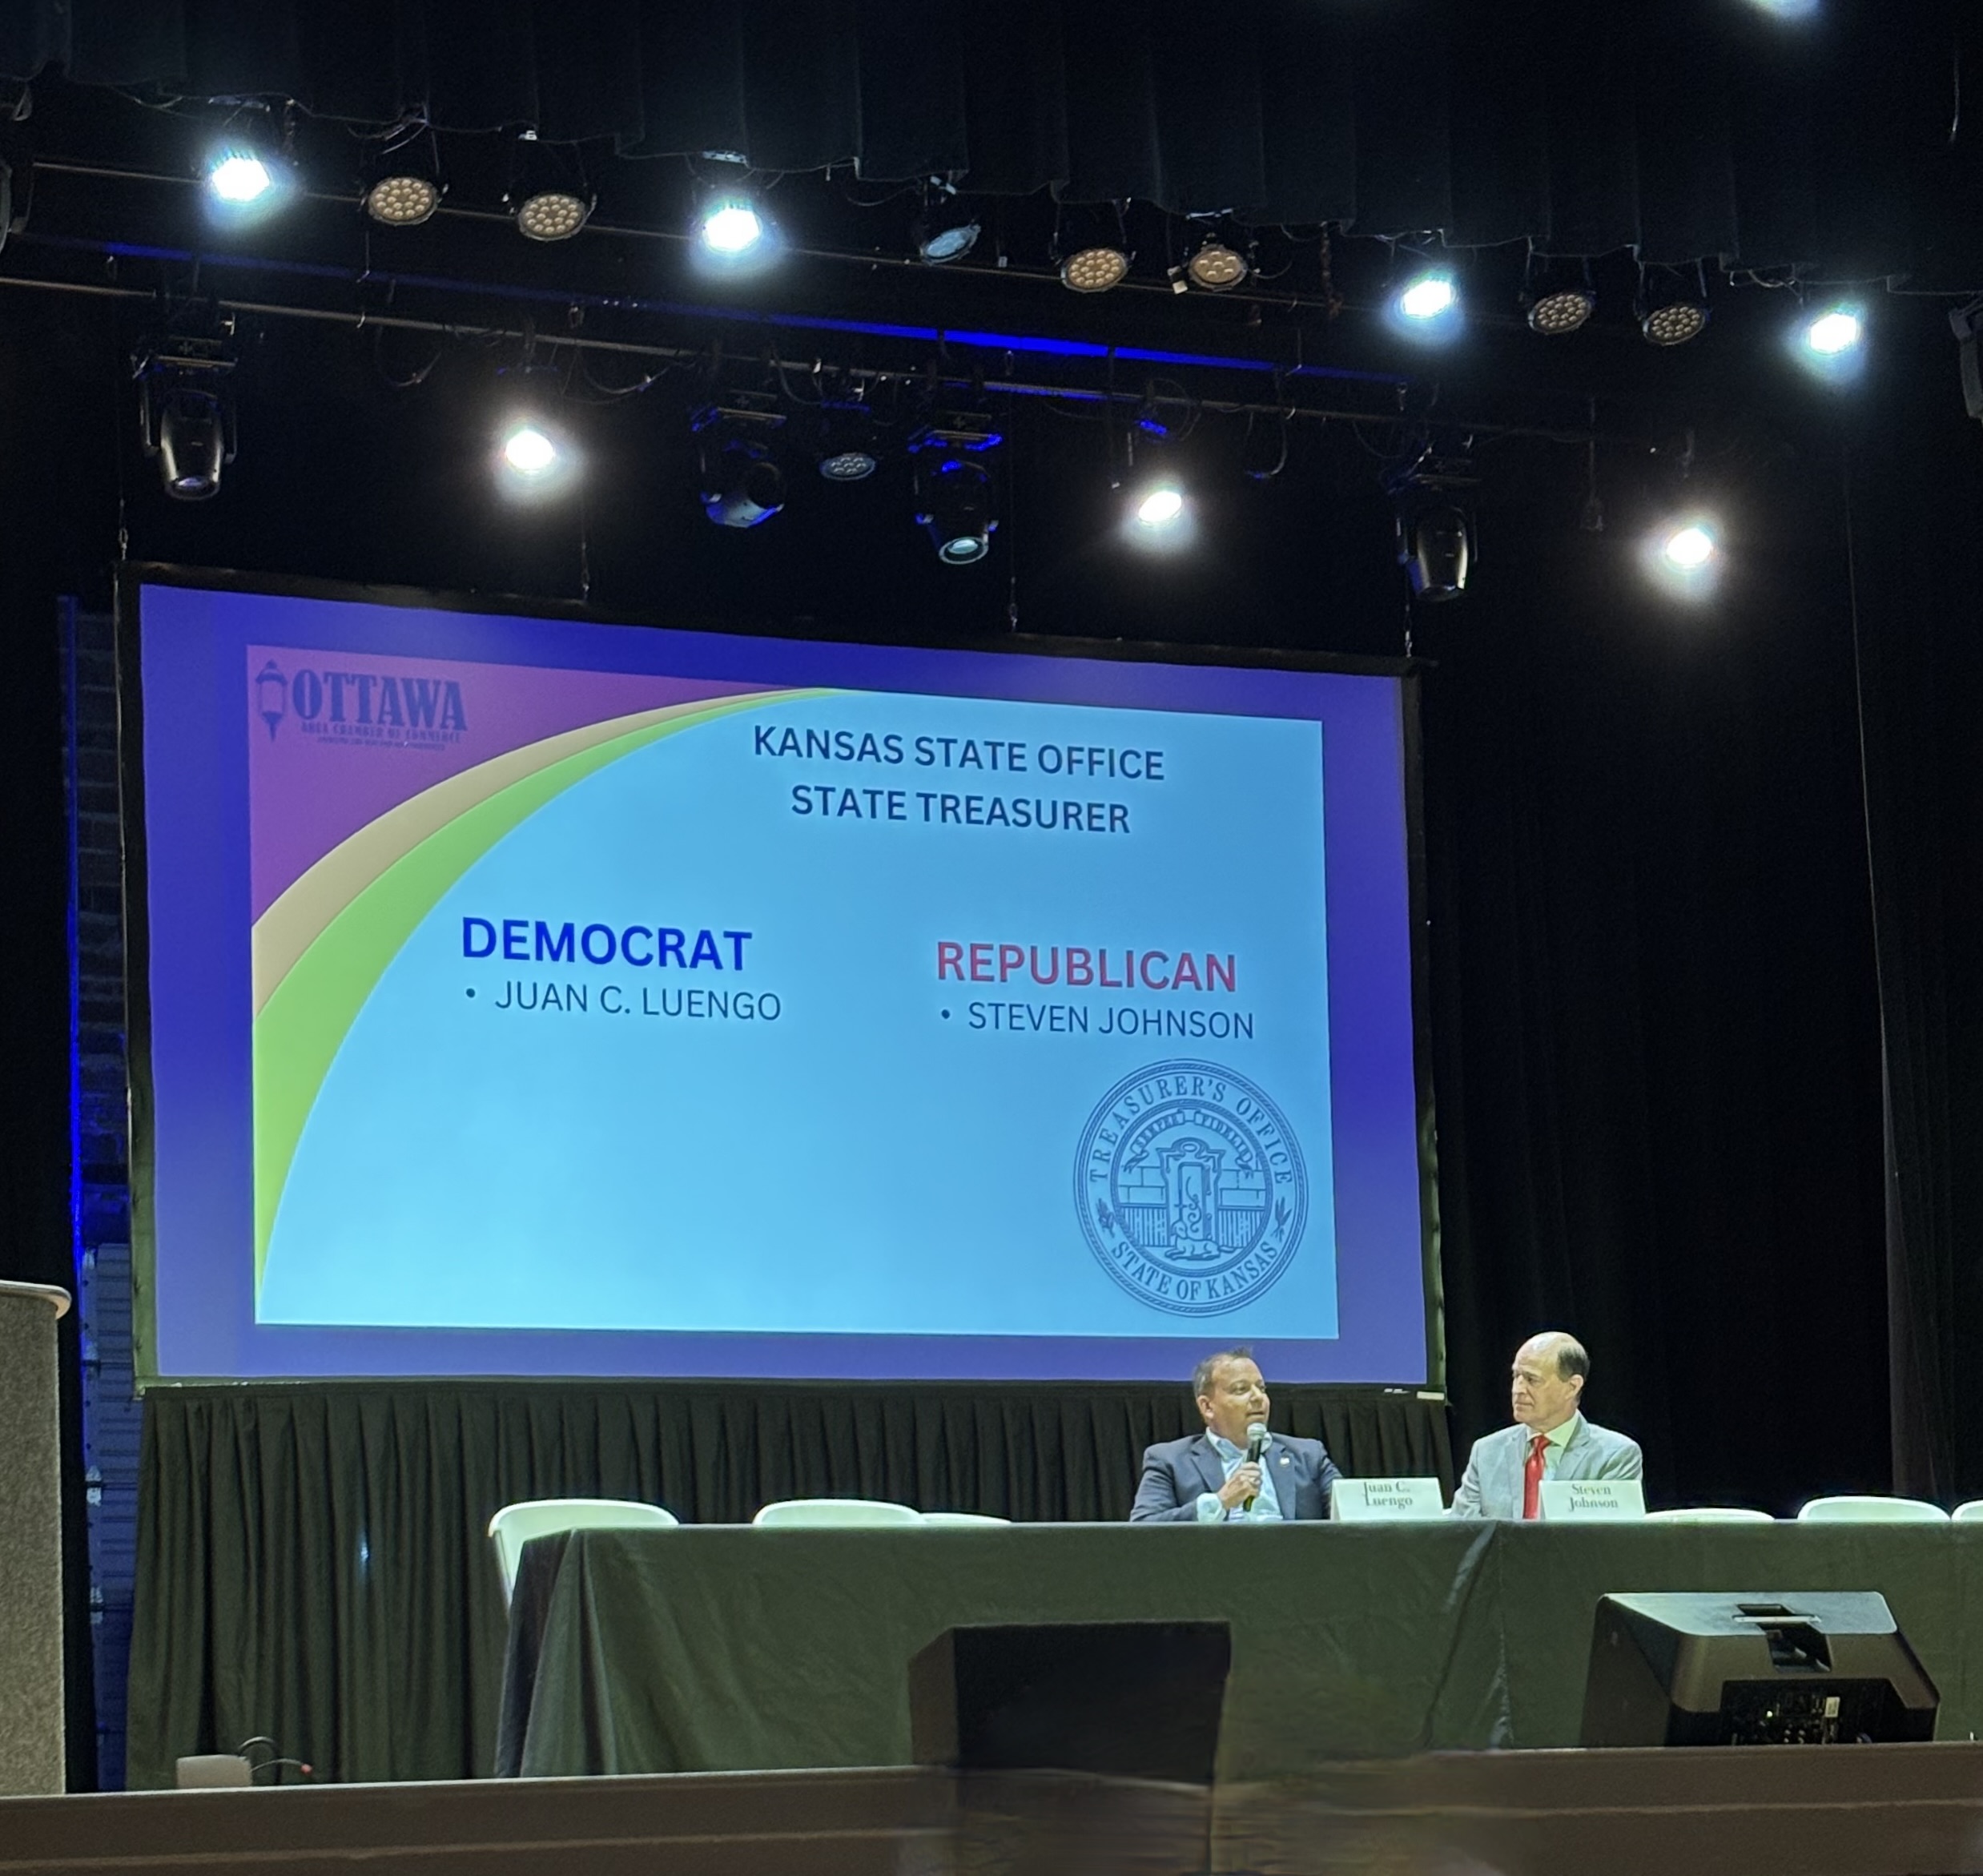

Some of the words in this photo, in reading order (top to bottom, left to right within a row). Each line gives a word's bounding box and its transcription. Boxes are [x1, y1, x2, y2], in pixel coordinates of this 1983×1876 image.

[292, 669, 468, 731] OTTAWA
[754, 725, 904, 764] KANSAS
[915, 736, 1028, 772] STATE
[1038, 744, 1164, 780] OFFICE
[791, 785, 907, 820] STATE
[916, 792, 1131, 833] TREASURER
[463, 916, 752, 971] DEMOCRAT
[937, 941, 1236, 992] REPUBLICAN
[495, 981, 587, 1012] JUAN
[600, 986, 630, 1014] C.
[642, 988, 781, 1021] LUENGO
[968, 1002, 1088, 1033] STEVEN
[1099, 1007, 1254, 1039] JOHNSON
[1090, 1075, 1227, 1182] TREASURER'S
[1236, 1097, 1293, 1184] OFFICE
[1112, 1242, 1170, 1295] STATE
[1177, 1280, 1201, 1301] OF
[1208, 1242, 1278, 1299] KANSAS
[1362, 1481, 1392, 1496] Juan
[1569, 1496, 1619, 1512] Johnson
[1571, 1483, 1611, 1495] Steven
